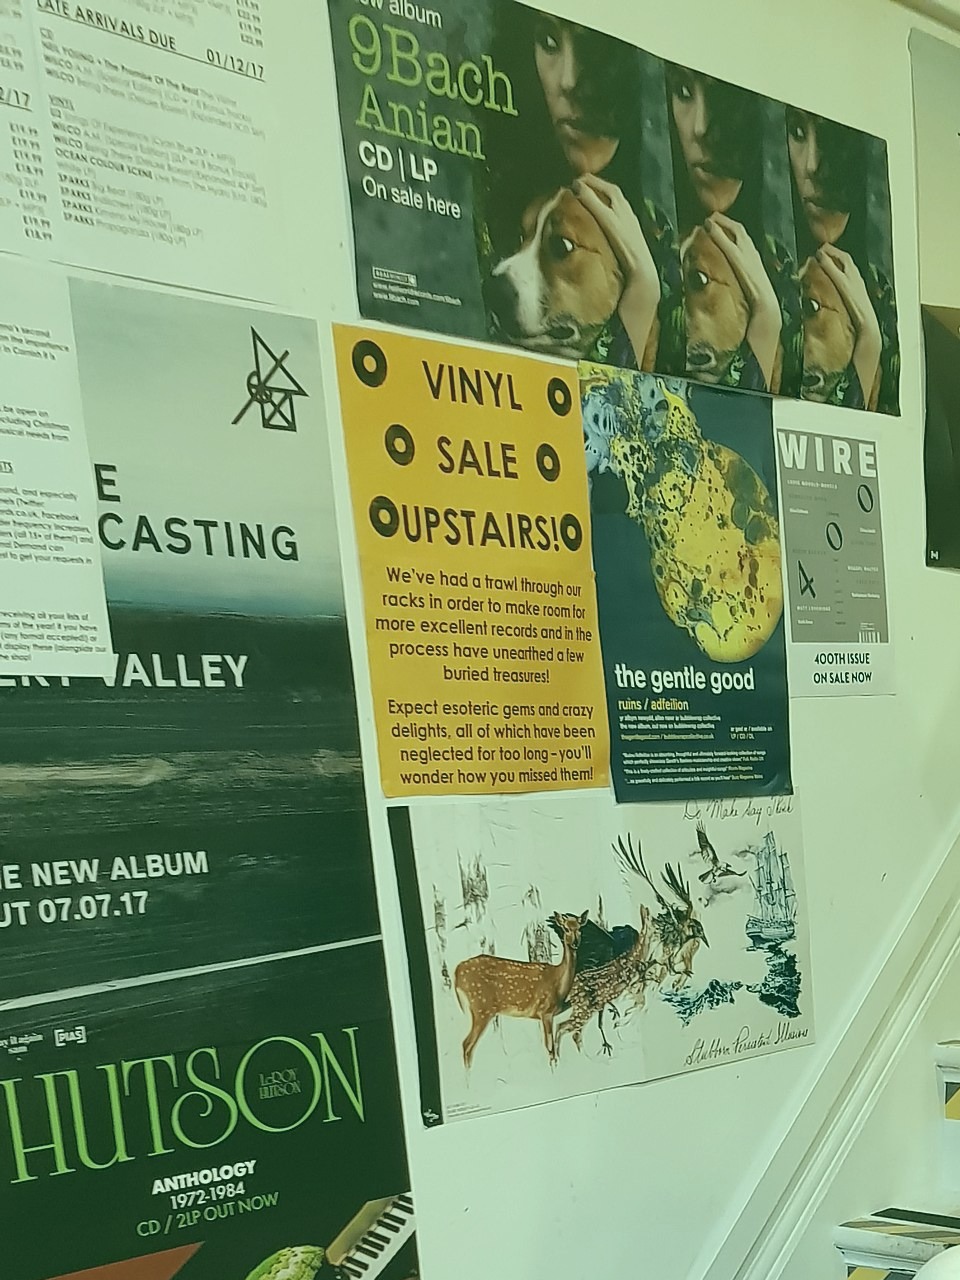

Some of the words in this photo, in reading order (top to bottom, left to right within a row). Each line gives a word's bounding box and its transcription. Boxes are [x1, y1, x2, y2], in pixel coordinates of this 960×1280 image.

[388, 0, 443, 29] album
[75, 5, 144, 41] ARRIVALS
[149, 29, 176, 50] DUE
[206, 48, 265, 79] 01/12/17
[348, 13, 519, 117] 9Bach
[355, 83, 487, 161] Anian
[358, 140, 394, 171] CD
[409, 153, 438, 183] LP
[362, 175, 388, 200] On
[390, 186, 424, 209] sale
[426, 191, 462, 219] here
[422, 360, 523, 411] VINYL
[436, 435, 519, 480] SALE
[777, 431, 877, 478] WIRE
[97, 512, 299, 562] CASTING
[401, 504, 560, 552] UPSTAIRS!
[386, 566, 435, 585] We've
[439, 570, 468, 588] had
[472, 577, 481, 589] a
[485, 574, 518, 591] trawl
[520, 577, 564, 598] through
[566, 584, 581, 598] our
[382, 592, 425, 609] racks
[429, 593, 443, 609] in
[447, 595, 484, 612] order
[487, 598, 501, 613] to
[505, 600, 540, 616] make
[542, 606, 570, 619] room
[572, 604, 586, 619] for
[375, 617, 415, 631] more
[420, 619, 487, 636] excellent
[491, 623, 538, 639] records
[540, 625, 562, 640] and
[564, 626, 574, 641] in
[575, 626, 592, 642] the
[389, 642, 449, 659] process
[453, 642, 489, 659] have
[493, 645, 553, 662] unearthed
[556, 650, 565, 663] a
[566, 647, 584, 663] few
[814, 653, 846, 666] 400TH
[847, 652, 870, 665] ISSUE
[443, 665, 489, 682] buried
[493, 667, 550, 684] treasures!
[614, 663, 647, 689] the
[650, 666, 706, 694] gentle
[710, 667, 755, 695] good
[813, 672, 828, 685] ON
[830, 672, 850, 684] SALE
[852, 671, 872, 683] NOW
[388, 699, 438, 718] Expect
[442, 701, 499, 716] esoteric
[503, 704, 535, 720] gems
[538, 702, 560, 717] and
[562, 704, 594, 720] crazy
[618, 697, 642, 711] ruins
[391, 722, 452, 741] delights,
[455, 723, 473, 739] all
[477, 724, 490, 739] of
[494, 724, 531, 739] which
[533, 724, 561, 739] have
[563, 724, 596, 739] been
[400, 746, 474, 765] neglected
[477, 746, 496, 761] for
[499, 746, 520, 761] too
[523, 747, 549, 763] long
[559, 745, 592, 763] you'll
[400, 769, 454, 784] wonder
[457, 769, 487, 784] how
[489, 770, 515, 786] you
[519, 767, 557, 783] missed
[560, 766, 594, 782] them!
[30, 858, 100, 887] NEW
[110, 850, 210, 881] ALBUM
[37, 890, 149, 924] 07.07.17
[0, 1026, 366, 1185] HUTSON
[151, 1159, 257, 1195] ANTHOLOGY
[169, 1180, 246, 1210] 1972-1984
[136, 1219, 162, 1237] CD
[175, 1210, 202, 1229] 2LP
[203, 1202, 237, 1221] OUT
[238, 1191, 280, 1213] NOW
